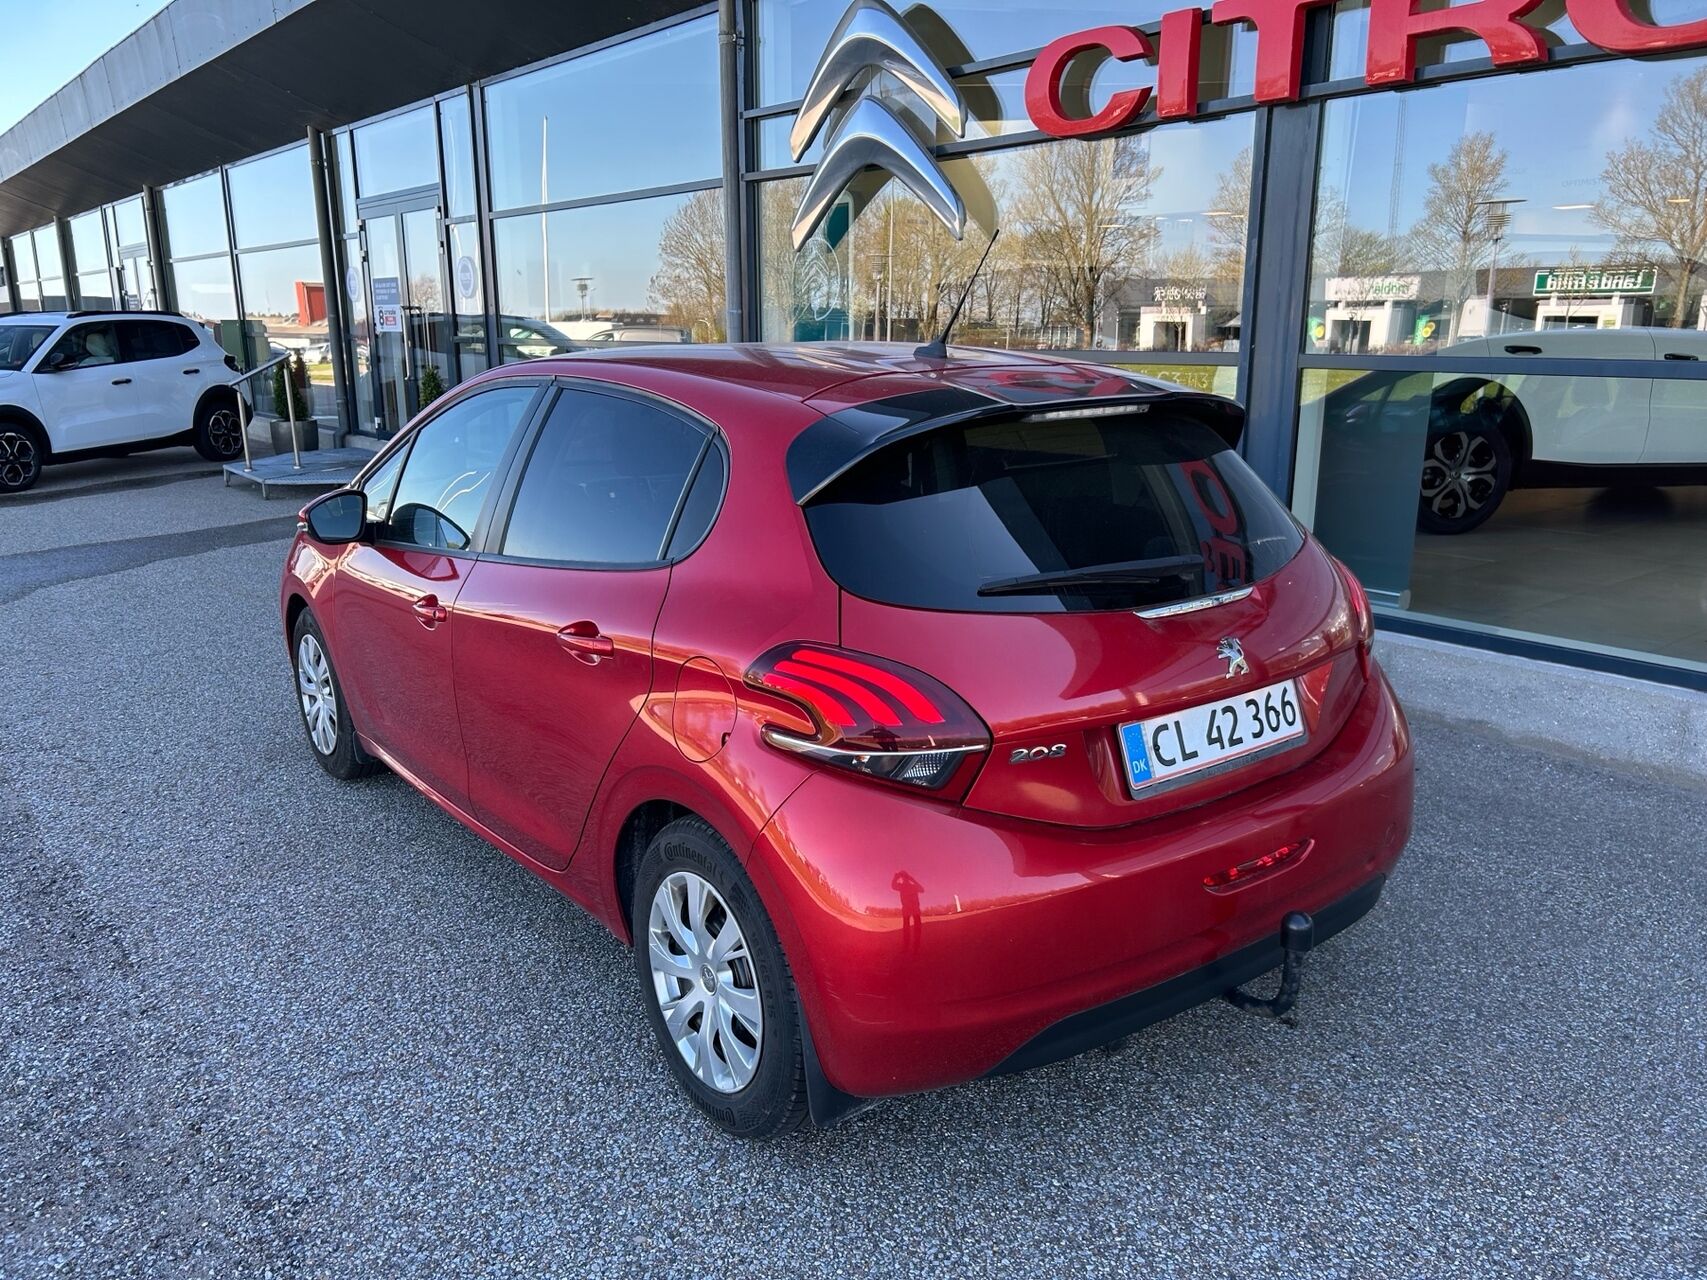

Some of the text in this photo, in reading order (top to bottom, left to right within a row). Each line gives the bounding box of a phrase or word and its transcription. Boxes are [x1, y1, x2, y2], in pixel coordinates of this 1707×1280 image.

[1152, 720, 1199, 767] CL
[1206, 705, 1244, 751] 42
[1245, 686, 1296, 740] 366
[1009, 743, 1067, 765] 208
[1132, 758, 1148, 774] DK
[664, 842, 718, 879] Continental
